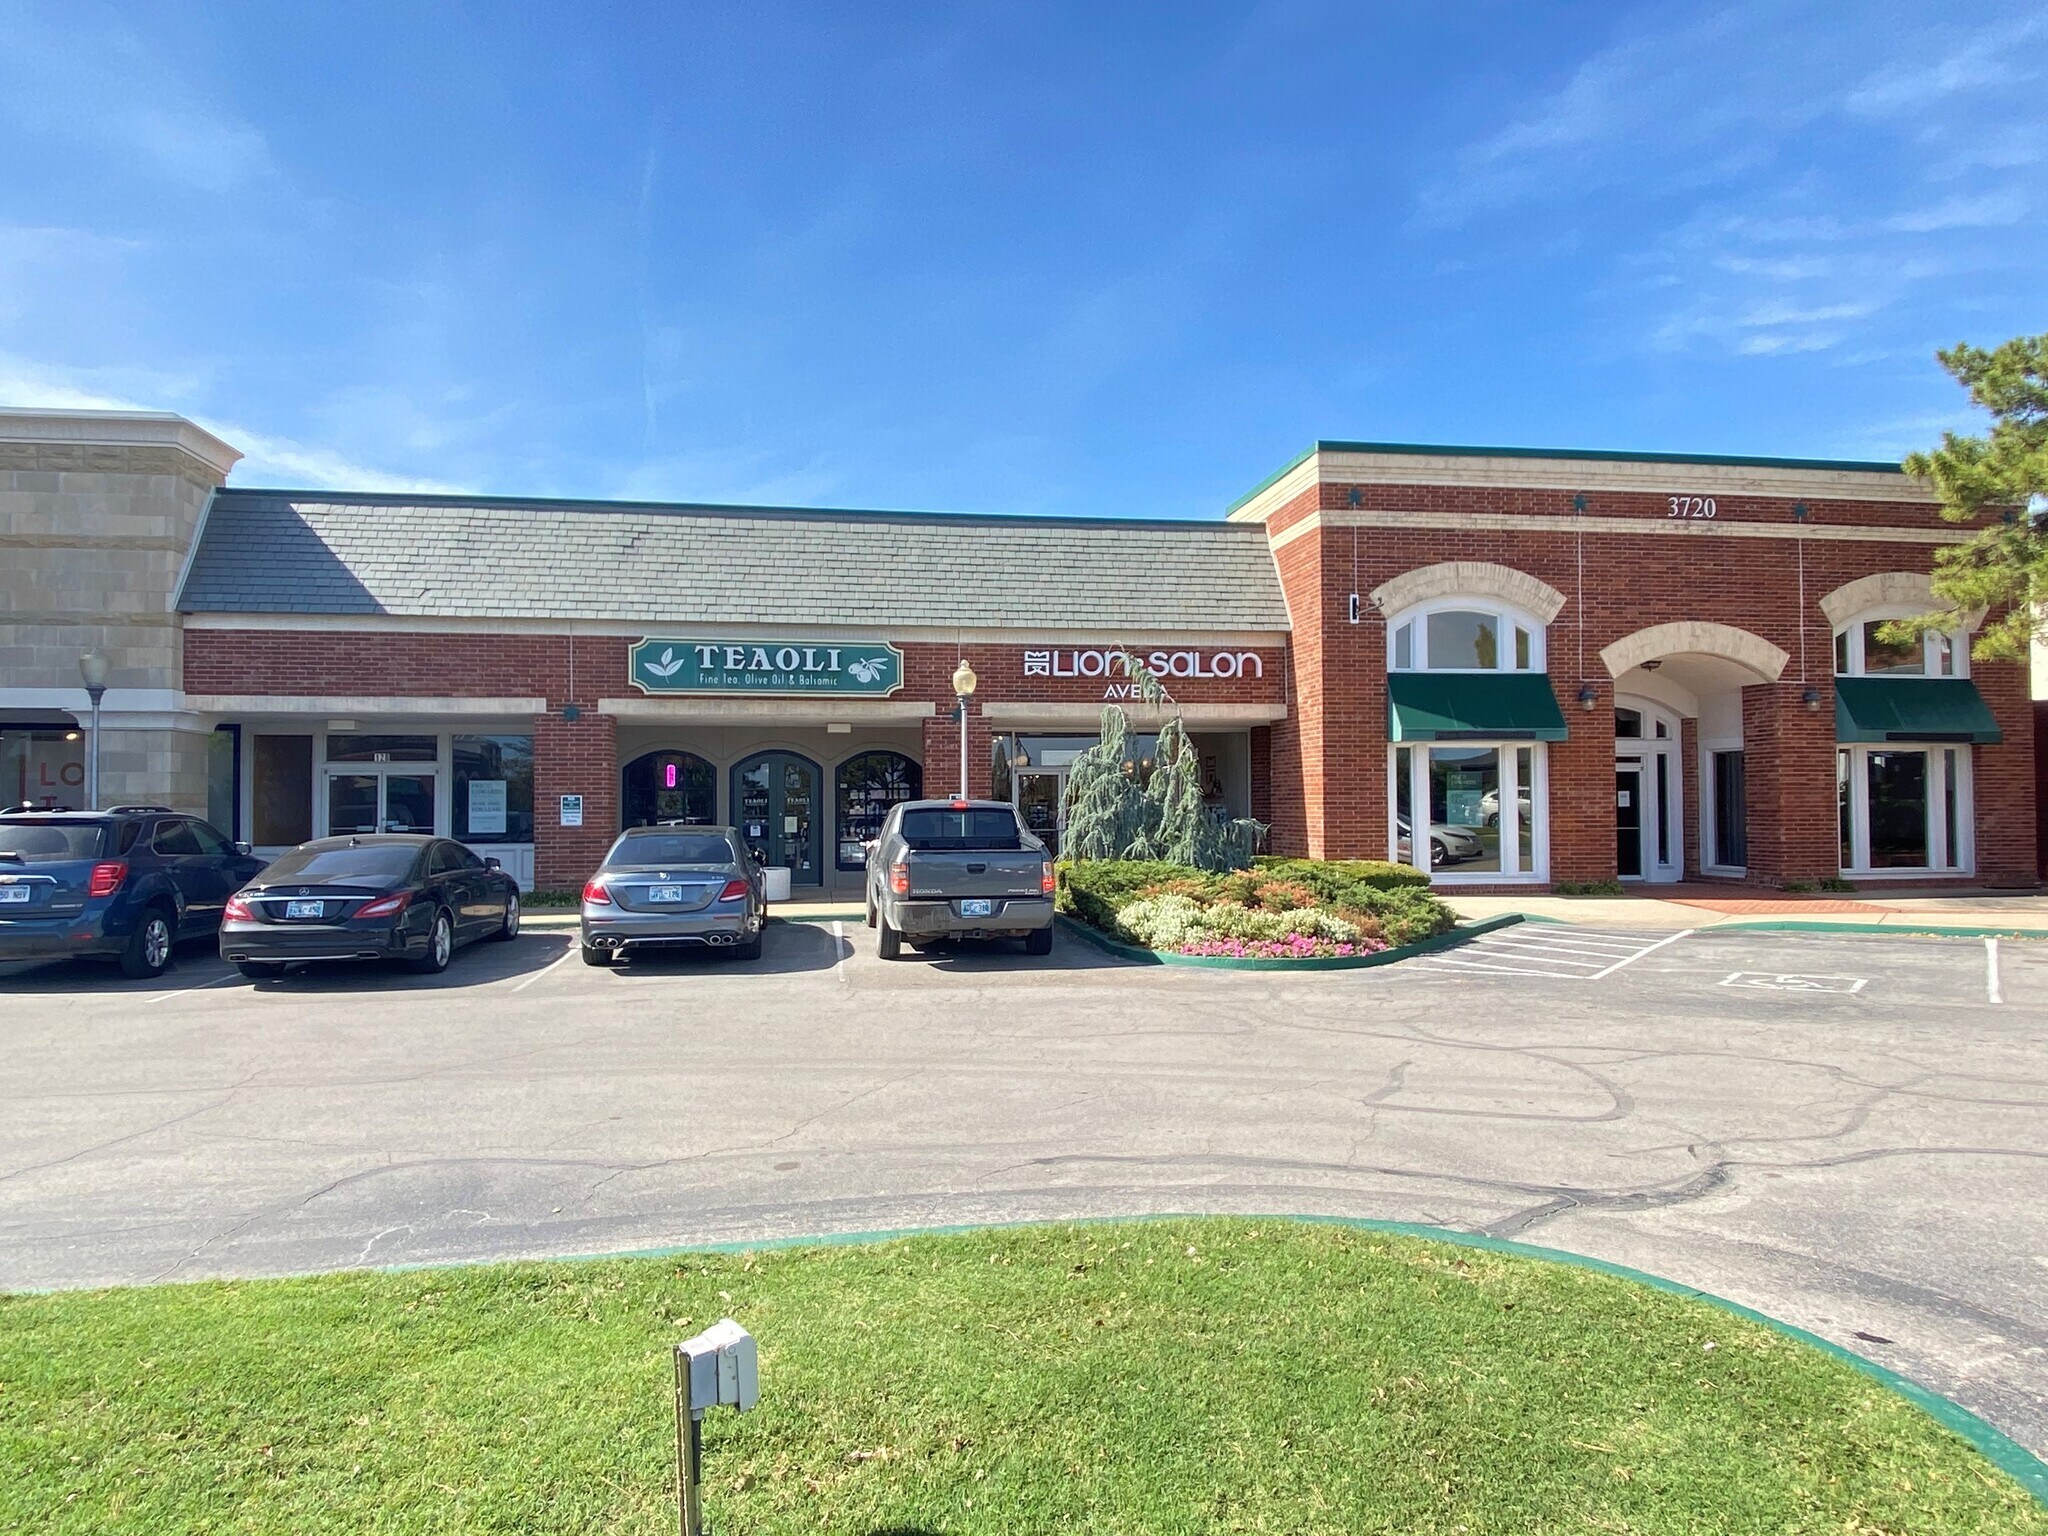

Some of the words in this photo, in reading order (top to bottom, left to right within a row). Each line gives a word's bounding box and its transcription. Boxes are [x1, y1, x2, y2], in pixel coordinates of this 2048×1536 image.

[1667, 496, 1717, 518] 3720
[694, 645, 842, 672] TEAOLI
[699, 673, 719, 685] Fine
[744, 673, 768, 686] Olive
[771, 673, 785, 686] Oil
[788, 673, 796, 686] &
[799, 674, 838, 687] Balsamic
